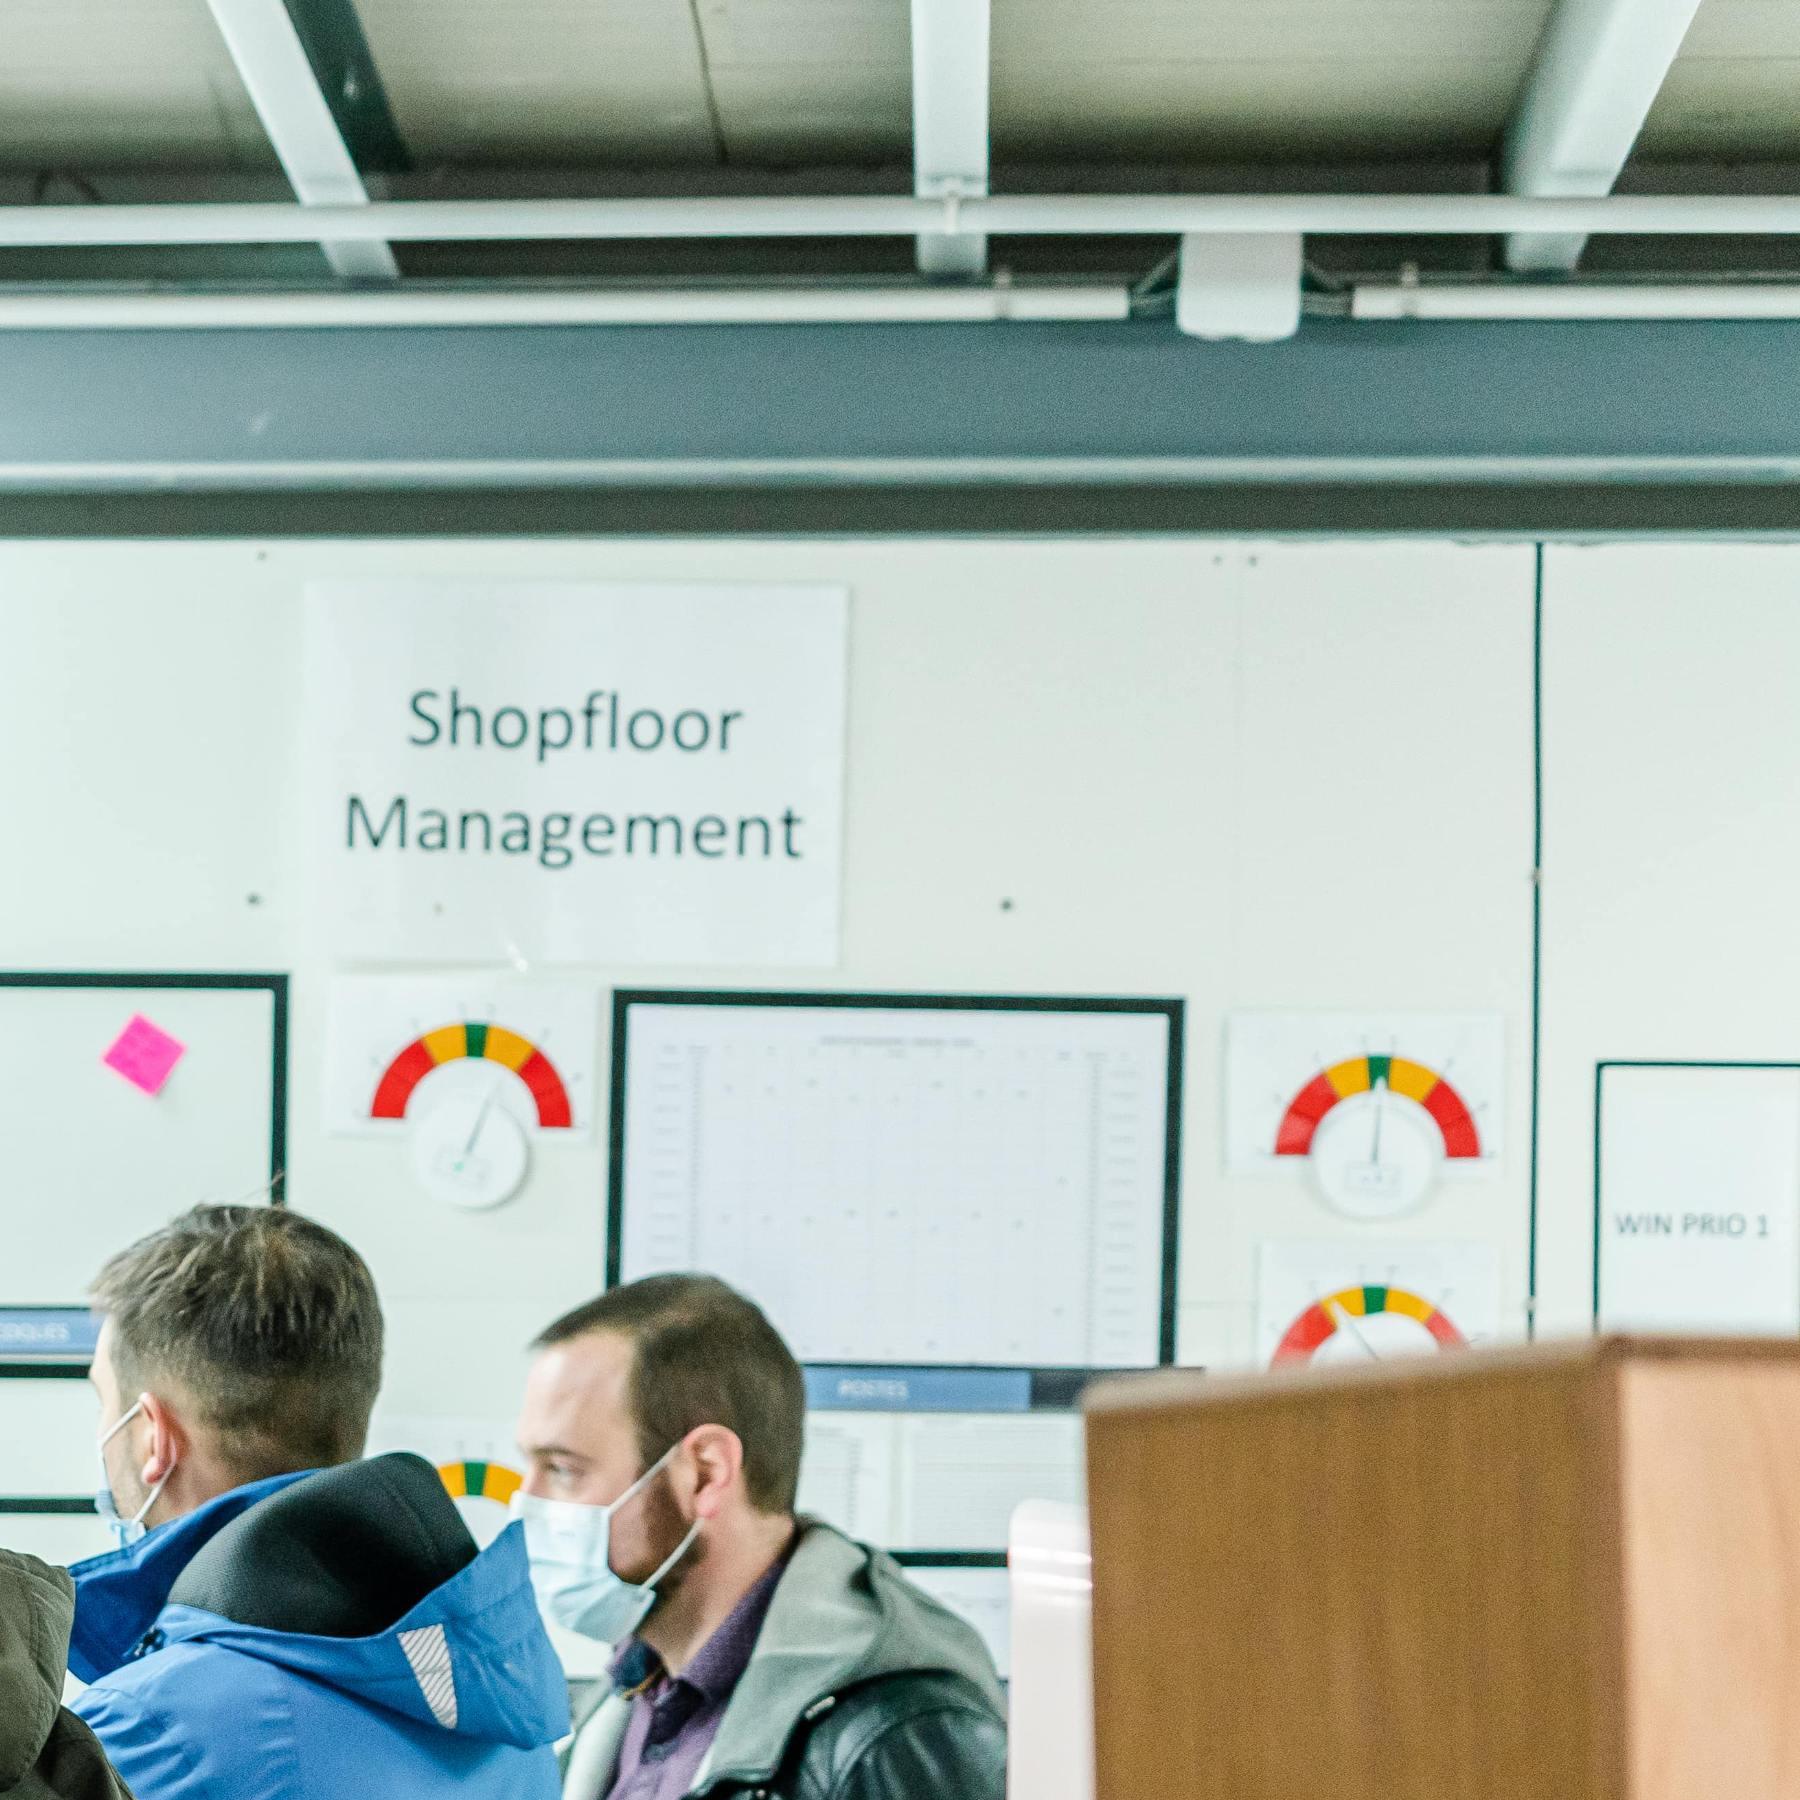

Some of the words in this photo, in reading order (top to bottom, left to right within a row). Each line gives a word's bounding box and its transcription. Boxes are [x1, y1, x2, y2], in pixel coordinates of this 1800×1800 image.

[407, 687, 744, 764] Shopfloor
[345, 793, 805, 870] Management
[1614, 1213, 1673, 1235] WIN
[1681, 1213, 1747, 1238] PRIO
[1756, 1213, 1770, 1237] 1
